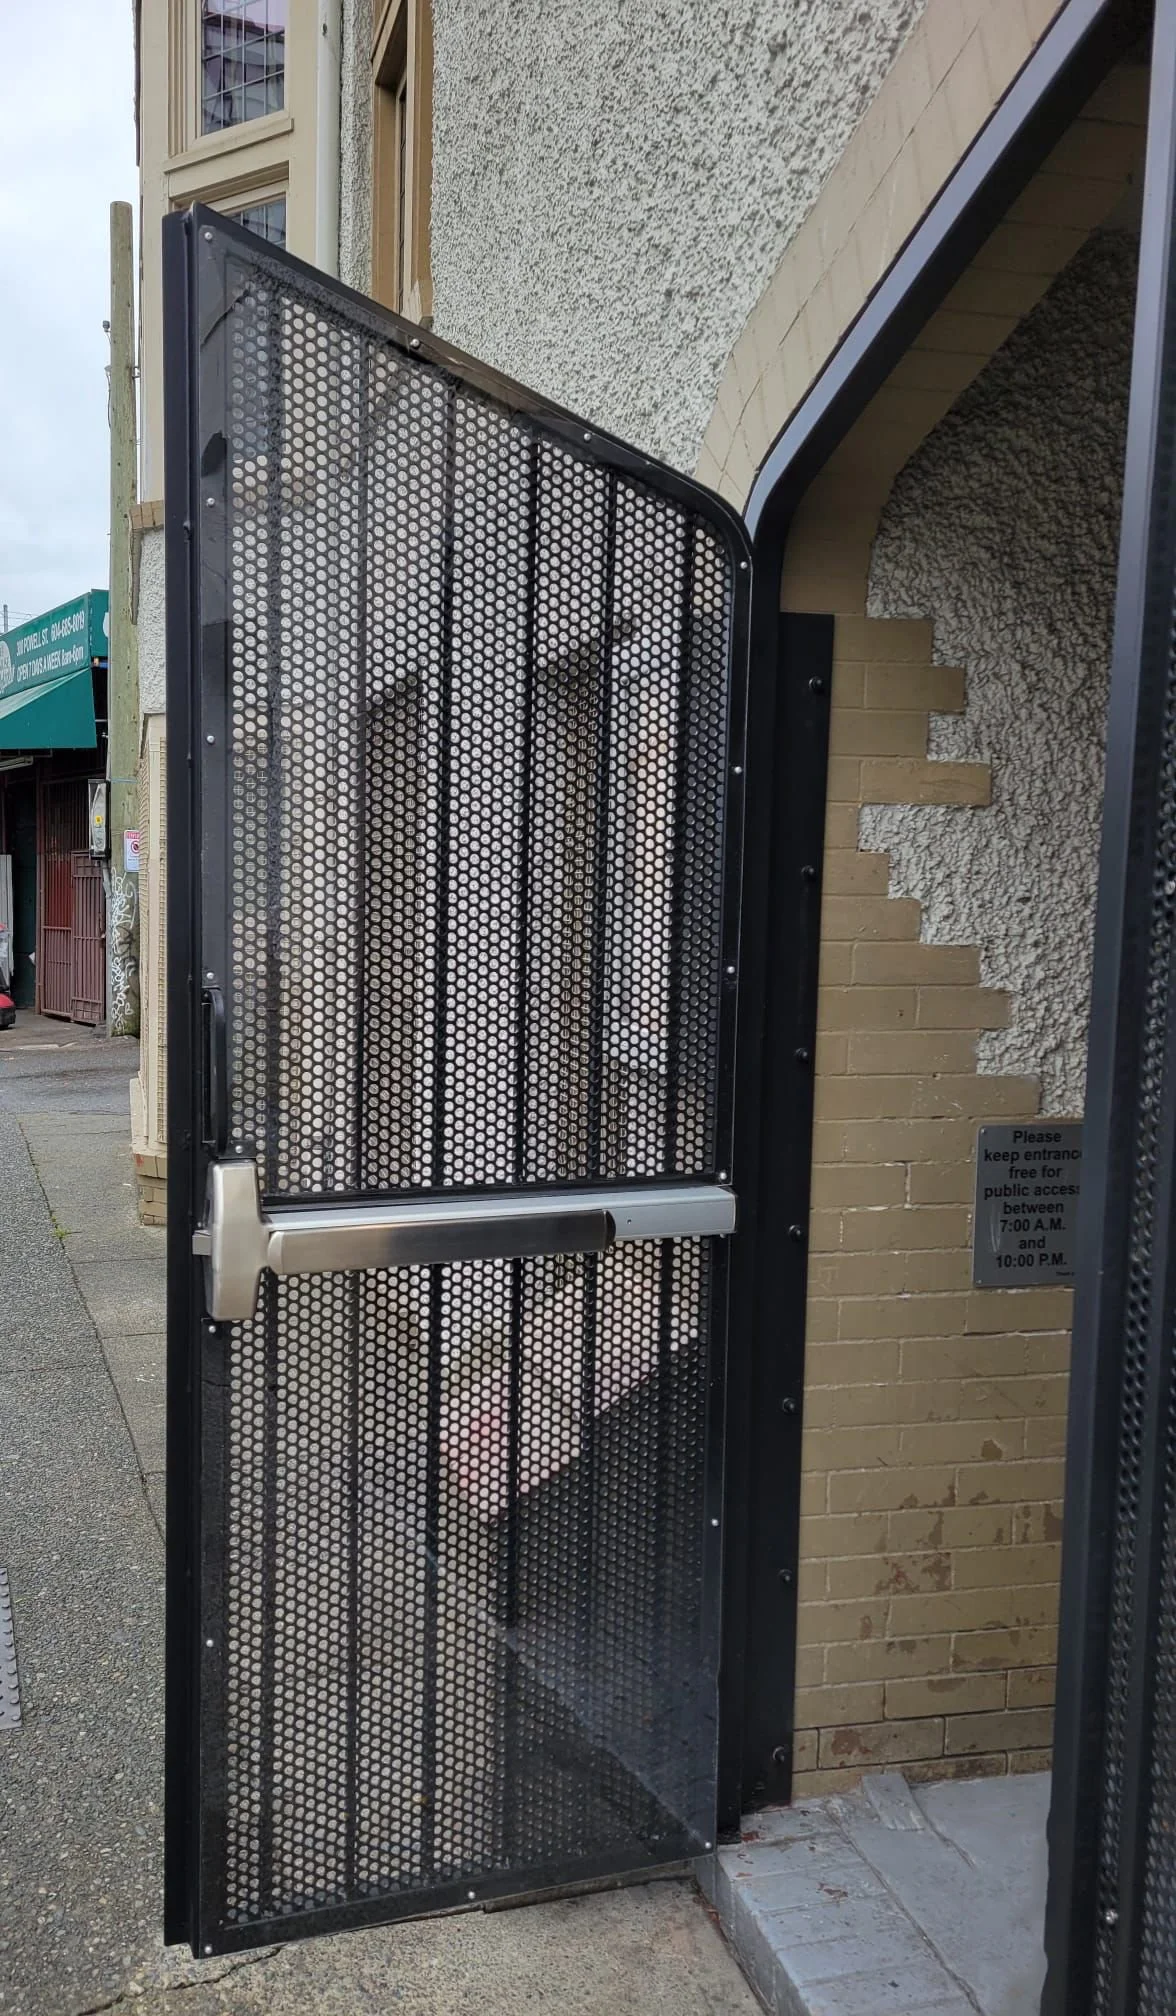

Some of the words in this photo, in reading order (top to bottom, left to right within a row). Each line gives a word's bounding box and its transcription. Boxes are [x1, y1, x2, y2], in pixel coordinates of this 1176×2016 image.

[24, 632, 41, 653] POWELL
[16, 663, 28, 683] OPEN
[31, 656, 43, 677] DAYS
[47, 650, 61, 670] WEEK
[1013, 1130, 1062, 1143] Please
[984, 1149, 1020, 1164] keep
[1024, 1148, 1082, 1161] entranc
[1008, 1166, 1037, 1179] free
[1042, 1165, 1063, 1178] for
[984, 1184, 1029, 1200] public
[1003, 1202, 1064, 1214] between
[1000, 1219, 1030, 1232] 7:00
[1034, 1218, 1067, 1231] A.M.
[1018, 1236, 1046, 1249] and
[996, 1254, 1034, 1268] 10:00
[1039, 1253, 1068, 1267] P.M.
